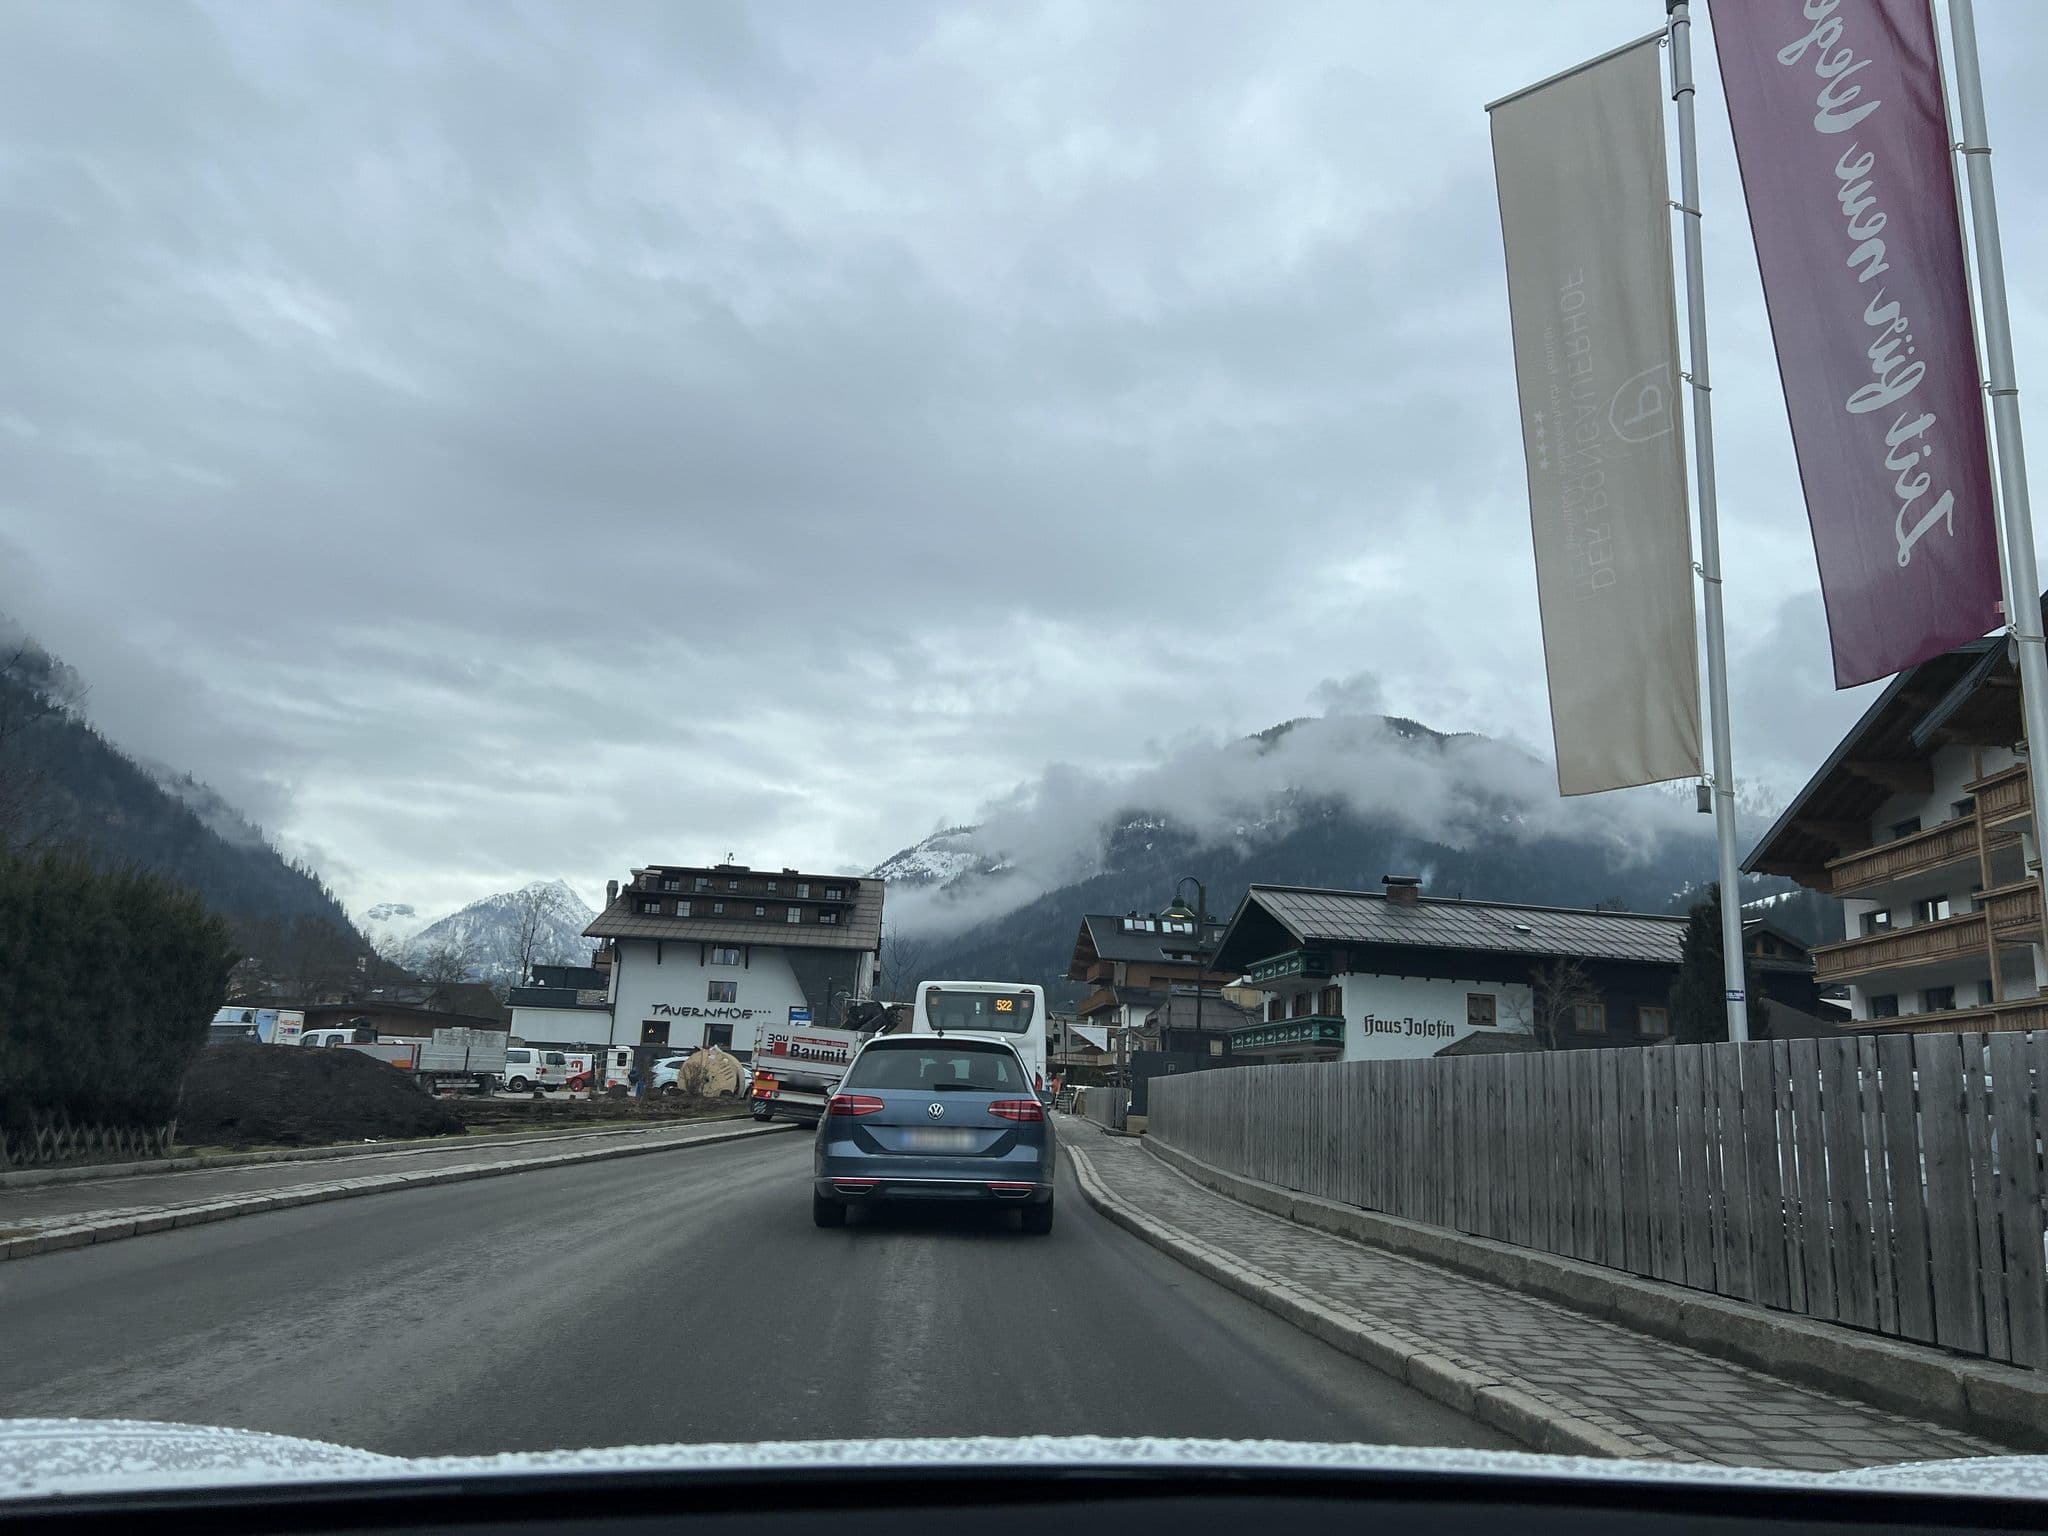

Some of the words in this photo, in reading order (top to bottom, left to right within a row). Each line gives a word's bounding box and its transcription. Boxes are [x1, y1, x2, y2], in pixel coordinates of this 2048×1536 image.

[652, 1003, 754, 1020] TAUERNHOF
[996, 999, 1013, 1012] 522
[1364, 1013, 1402, 1036] Haus
[790, 1042, 848, 1063] Baumit
